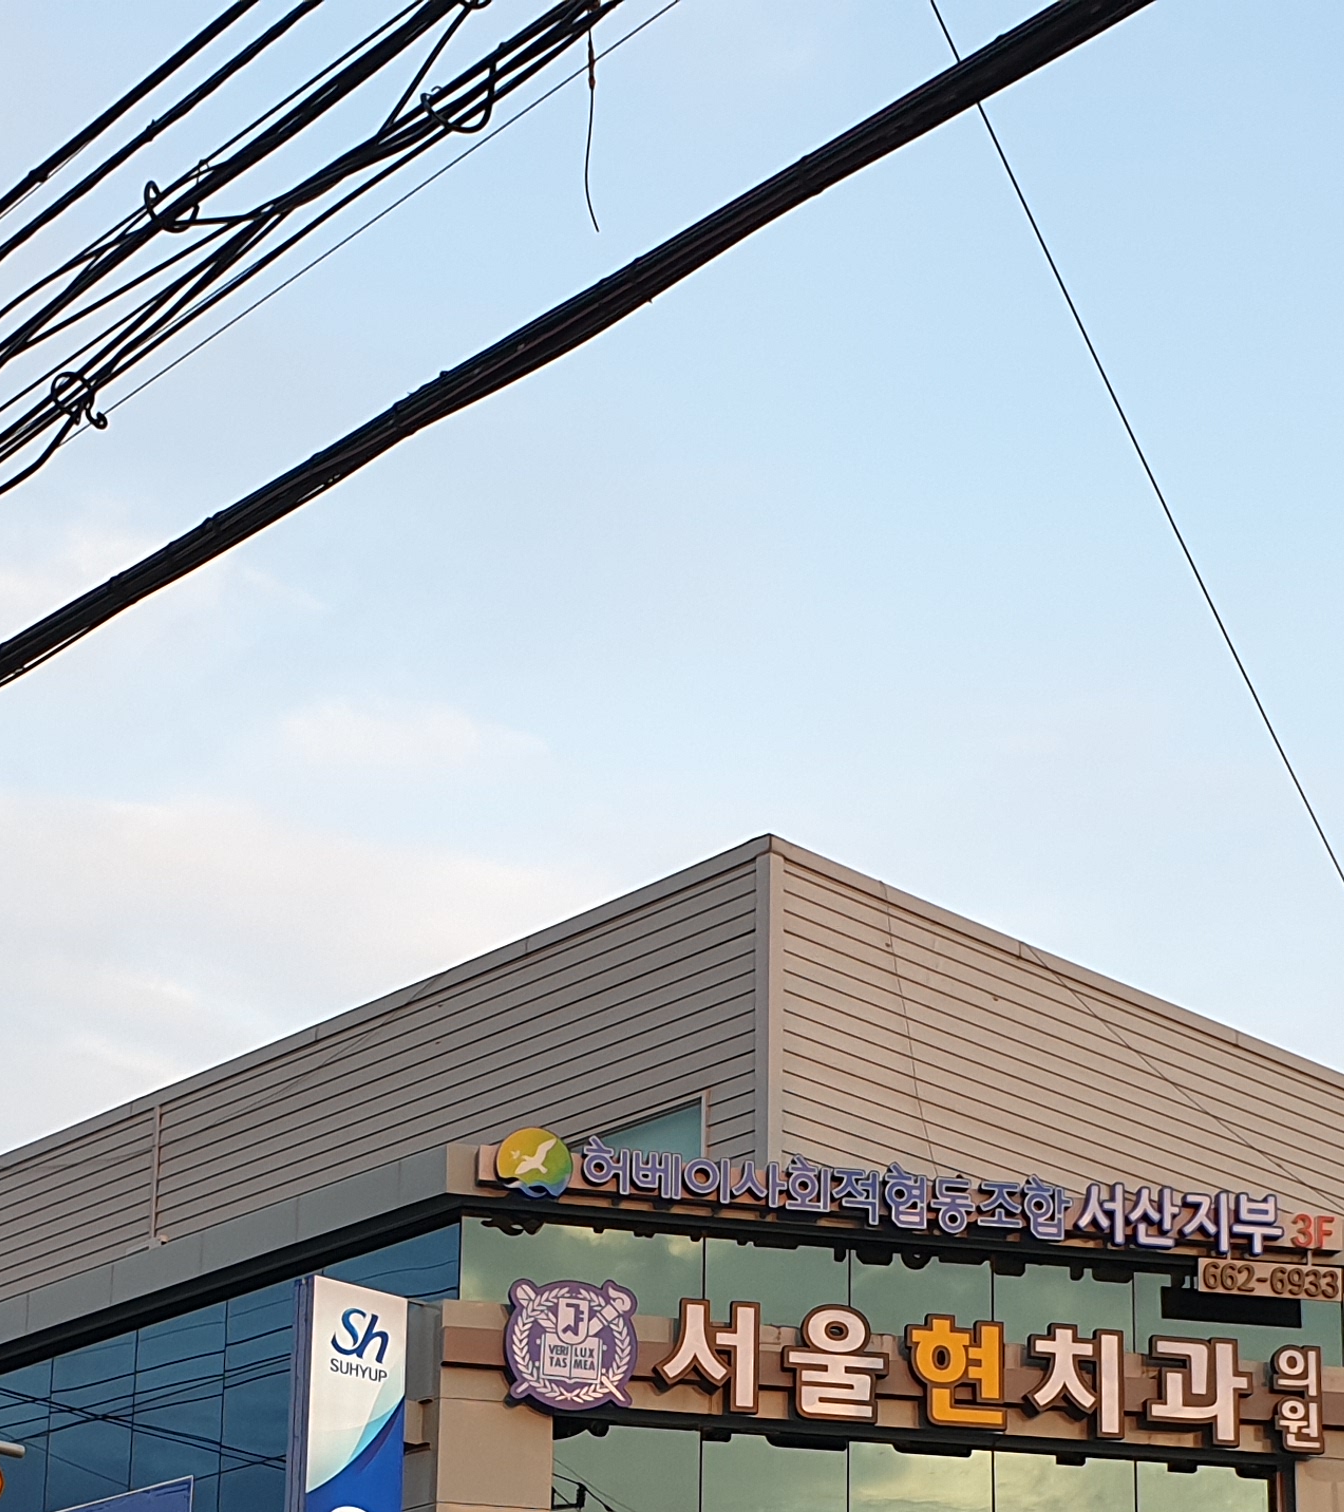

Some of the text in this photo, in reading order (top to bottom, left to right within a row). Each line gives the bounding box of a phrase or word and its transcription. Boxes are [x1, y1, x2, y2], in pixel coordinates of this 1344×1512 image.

[583, 1139, 1336, 1256] 허베이사회적협동조합 서산지부 3F
[1201, 1261, 1341, 1300] 662-6933
[331, 1306, 390, 1364] Sh
[574, 1347, 595, 1358] LUX
[330, 1357, 388, 1383] SUHYUP
[549, 1356, 567, 1368] TAS
[573, 1360, 595, 1371] MEA
[657, 1298, 1252, 1446] 서울현치과
[1274, 1348, 1320, 1452] 의원
